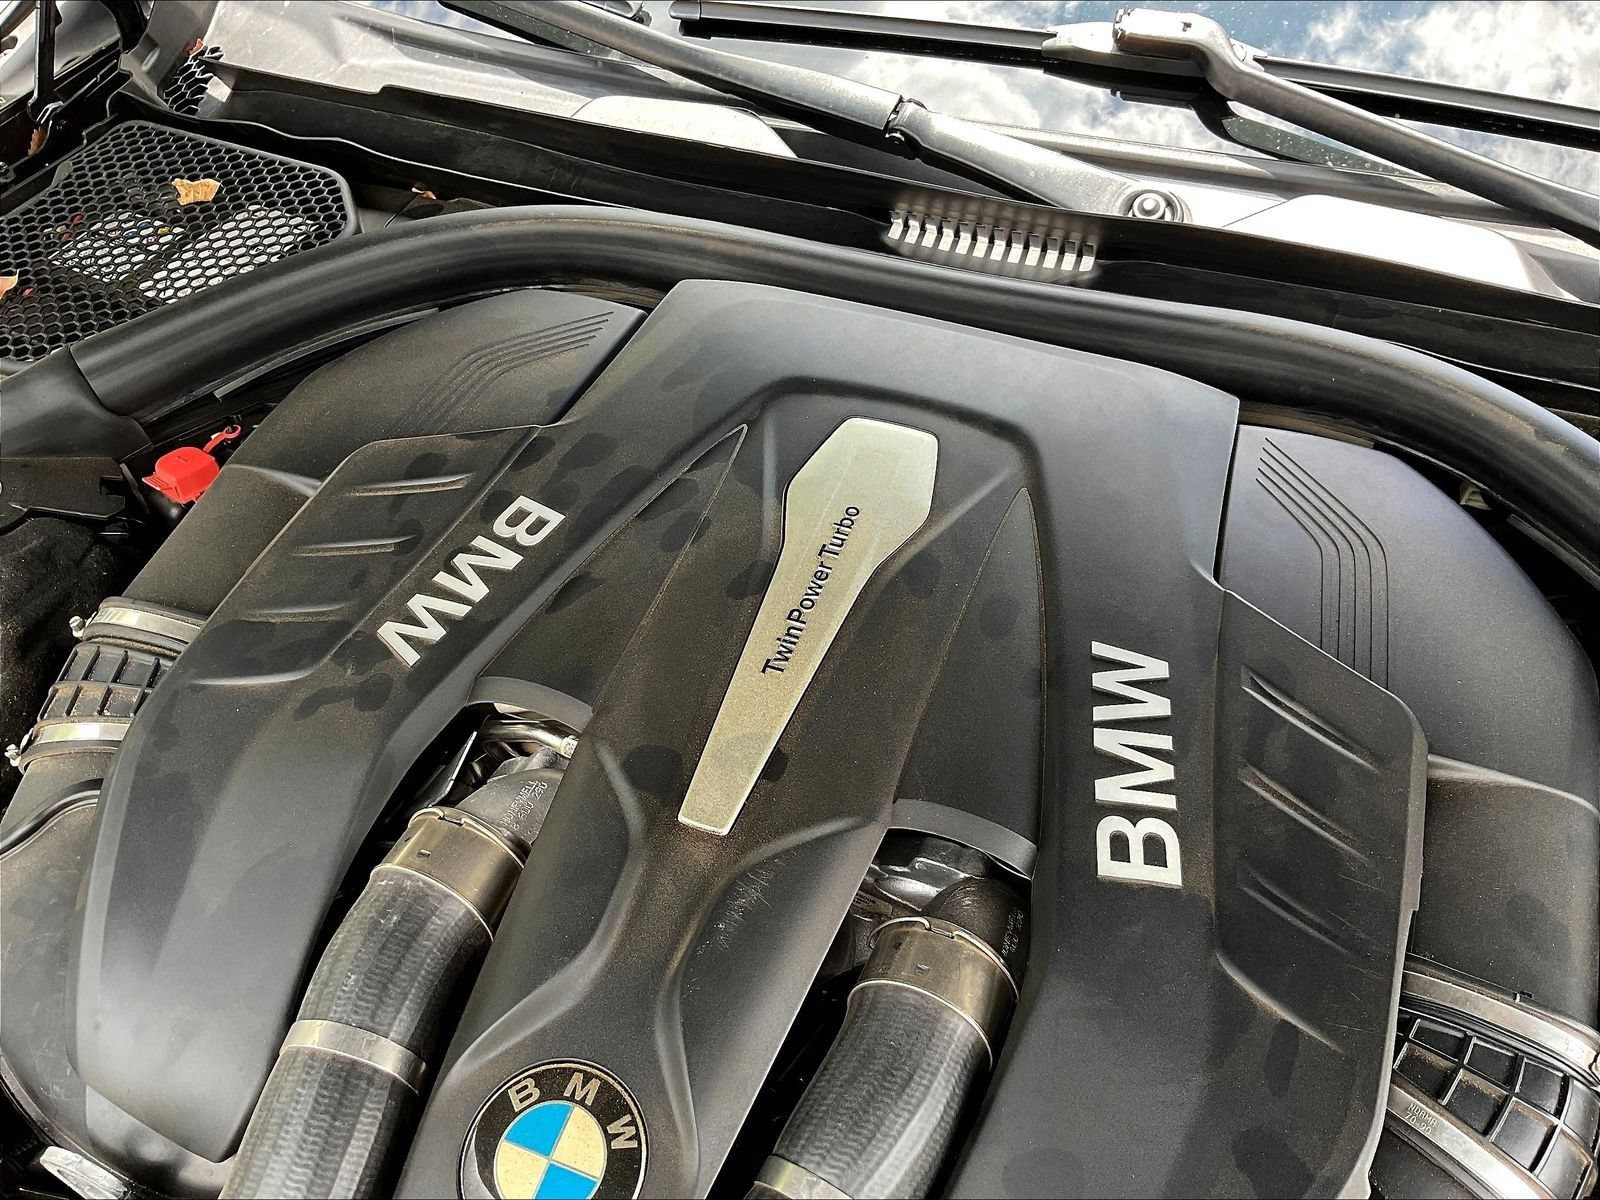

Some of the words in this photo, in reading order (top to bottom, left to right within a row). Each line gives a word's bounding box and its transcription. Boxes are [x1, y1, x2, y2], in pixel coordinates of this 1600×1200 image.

[377, 495, 566, 668] BMW
[817, 506, 860, 558] Turbo
[1091, 640, 1183, 889] BMW
[508, 1071, 639, 1150] BMW
